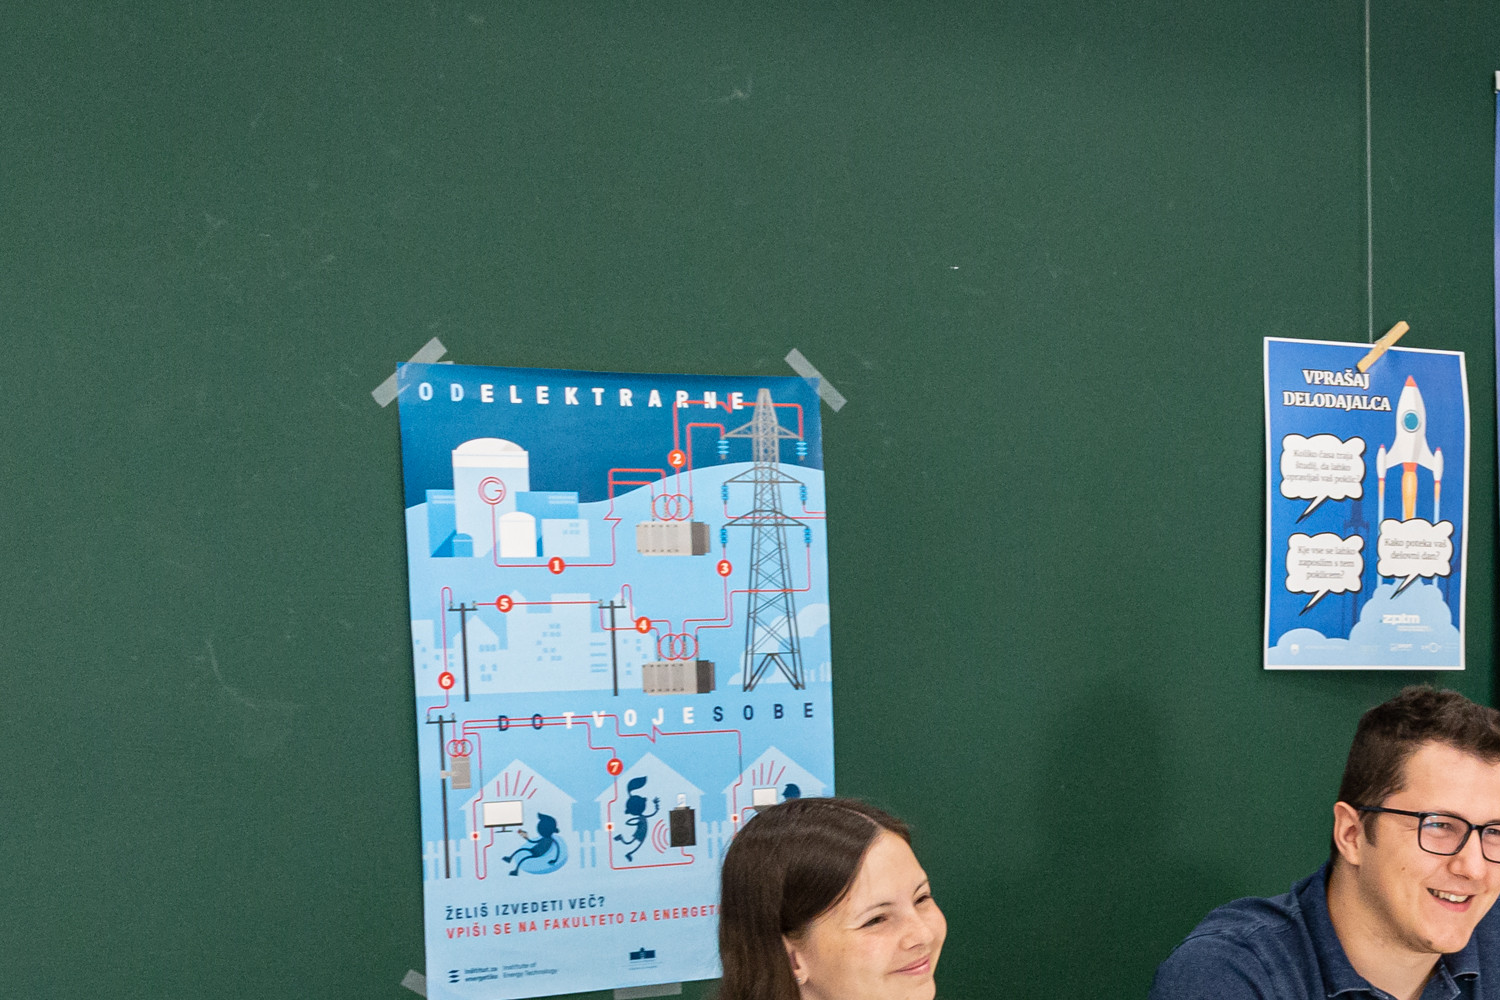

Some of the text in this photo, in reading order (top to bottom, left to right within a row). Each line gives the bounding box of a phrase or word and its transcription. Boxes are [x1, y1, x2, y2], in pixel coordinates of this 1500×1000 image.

[1302, 368, 1370, 390] VPRAŠAJ
[1282, 390, 1392, 411] DELODAJALCA
[673, 453, 682, 464] 2
[720, 563, 728, 574] 3
[501, 598, 509, 609] 5
[639, 620, 648, 631] 4
[442, 675, 451, 687] 6
[563, 707, 695, 729] TVOJE
[713, 702, 814, 722] SOBE
[611, 761, 620, 773] 7
[445, 895, 605, 920] ŽELIŠ IZVEDETI VEČ?
[446, 921, 488, 939] VPIŠI
[493, 923, 512, 935] SE
[519, 921, 537, 933] NA
[544, 912, 624, 931] FAKULTETO
[630, 911, 647, 923] ZA
